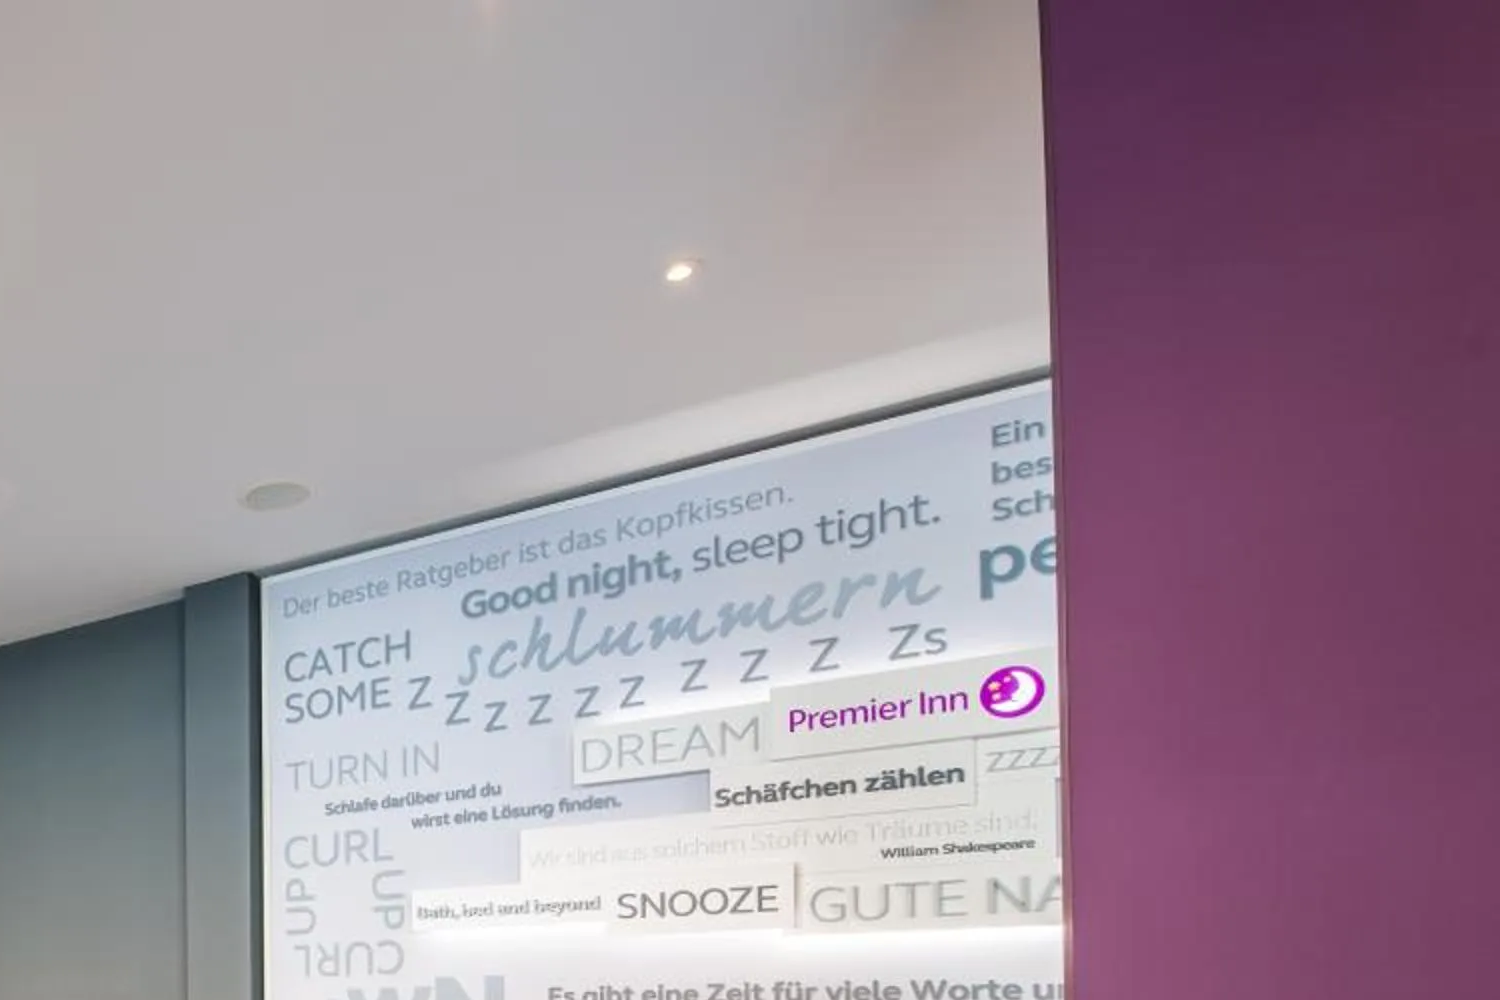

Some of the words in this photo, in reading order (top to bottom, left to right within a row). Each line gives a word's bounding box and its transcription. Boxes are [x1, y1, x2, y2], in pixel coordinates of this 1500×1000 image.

[991, 419, 1046, 448] Ein
[282, 597, 320, 619] Der
[327, 577, 390, 608] beste
[397, 549, 511, 592] Ratgeber
[519, 540, 550, 564] ist
[558, 525, 607, 556] das
[616, 486, 794, 541] Kopfkissen.
[461, 572, 558, 619] Good
[568, 548, 683, 599] night,
[692, 527, 803, 573] sleep
[814, 494, 941, 549] tight.
[458, 565, 942, 687] schlummern
[284, 629, 412, 683] CATCH
[285, 677, 391, 724] SOME
[888, 623, 948, 662] Zs
[788, 697, 912, 733] Premier
[919, 690, 969, 716] Inn
[286, 749, 388, 791] TURN
[402, 741, 441, 778] IN
[582, 716, 759, 773] DREAM
[325, 797, 378, 816] Schlafe
[381, 789, 442, 809] darüber
[445, 784, 474, 801] und
[476, 782, 503, 798] du
[714, 777, 857, 808] Schäfchen
[864, 765, 965, 793] zählen
[411, 809, 451, 829] wirst
[453, 807, 488, 826] eine
[491, 800, 555, 821] Lösung
[559, 794, 622, 814] finden.
[284, 828, 393, 869] CURL
[881, 845, 939, 860] William
[943, 838, 1036, 855] Shakespeare
[286, 878, 316, 935] UP
[372, 869, 405, 930] UP
[463, 901, 494, 918] bed
[498, 899, 531, 917] and
[534, 896, 601, 917] beyond
[617, 885, 779, 920] SNOOZE
[810, 879, 969, 923] GUTE
[294, 939, 405, 978] CURL
